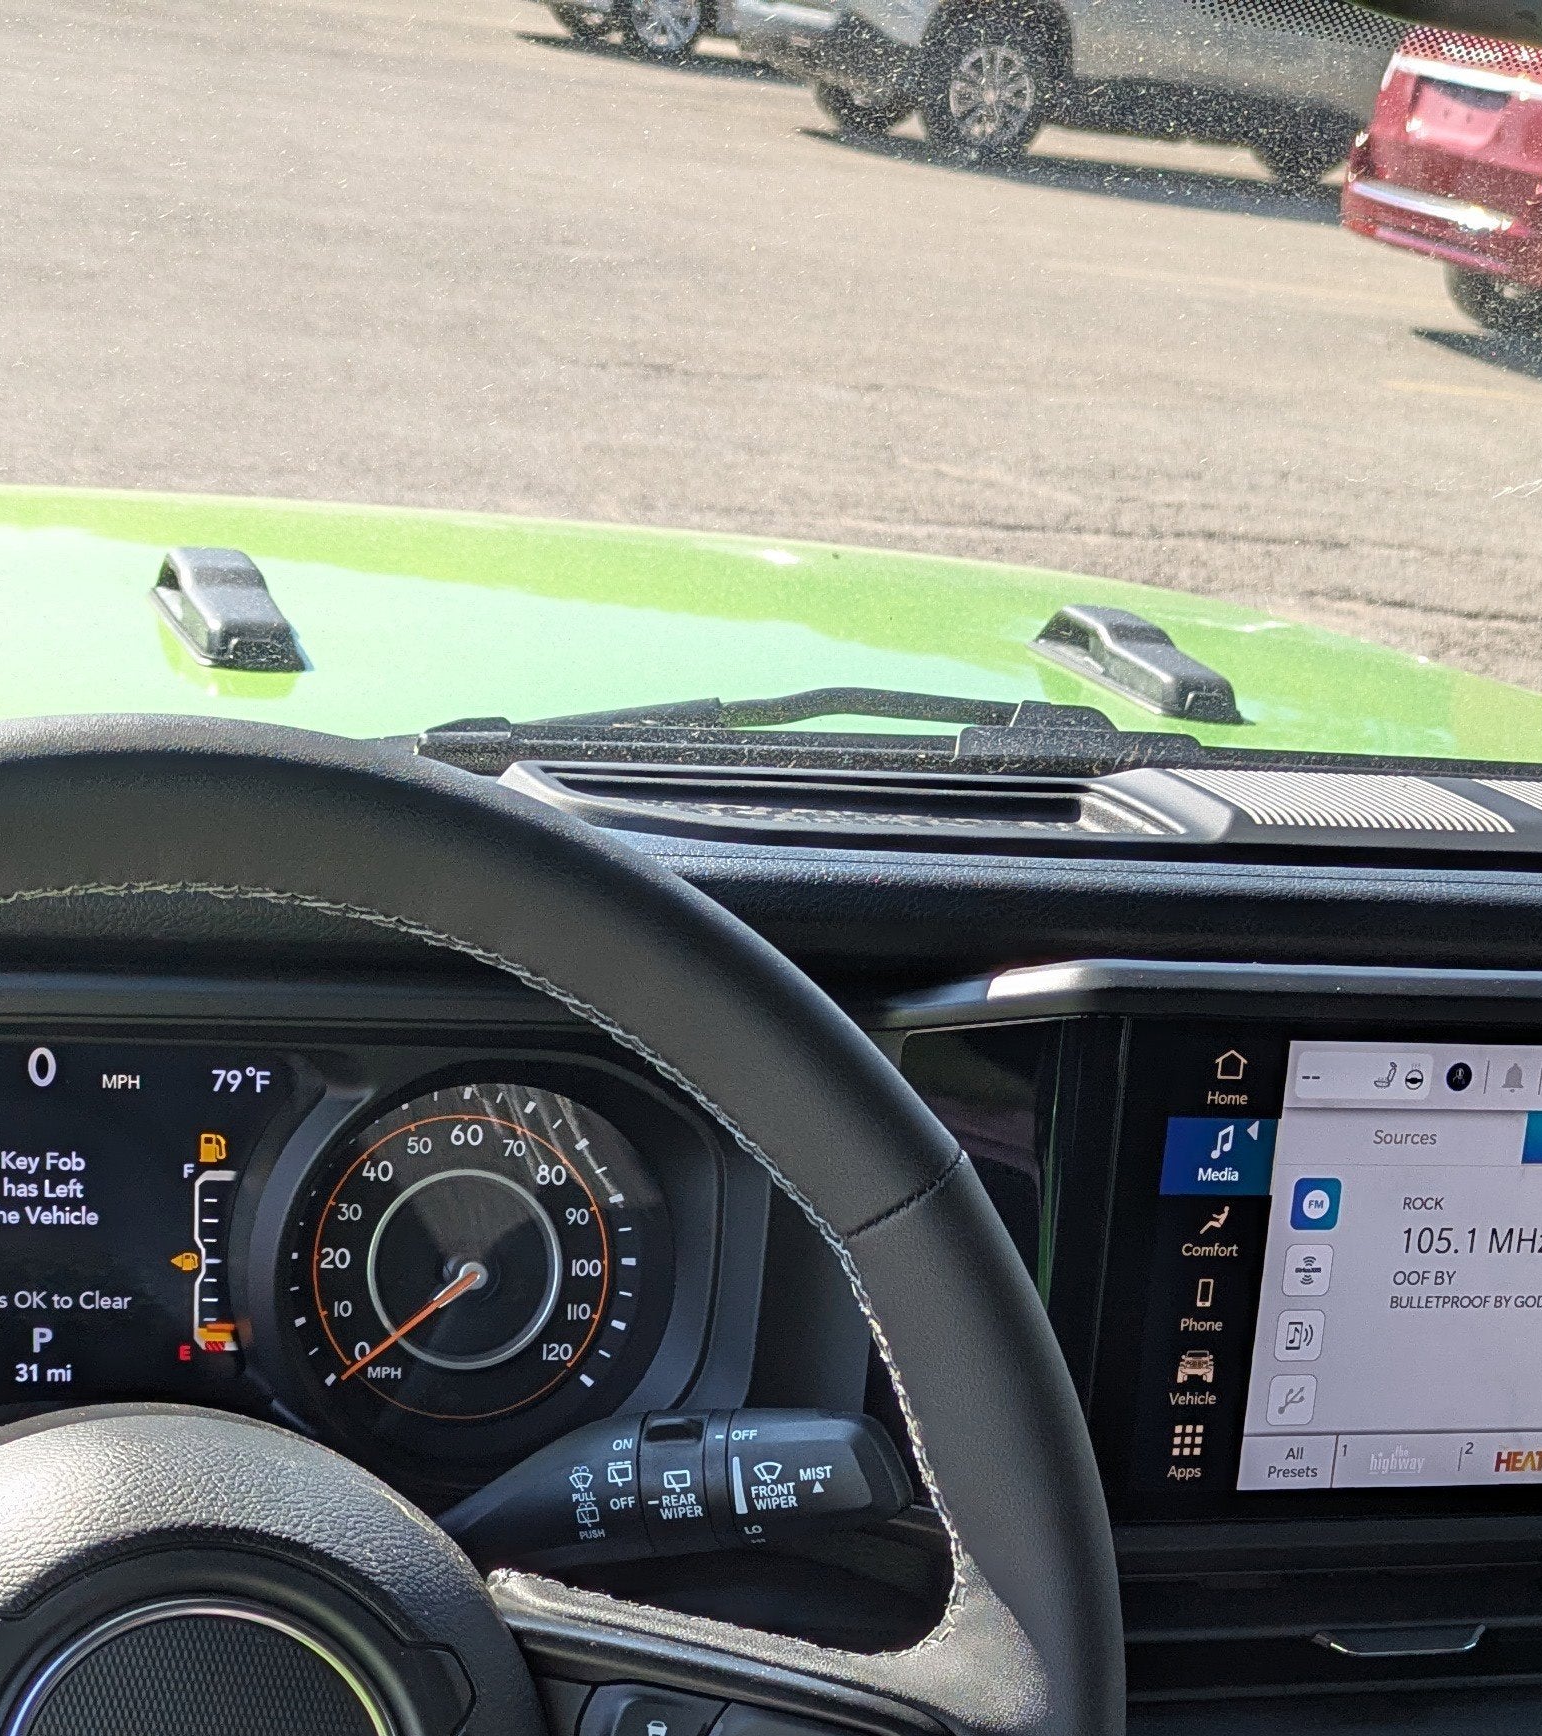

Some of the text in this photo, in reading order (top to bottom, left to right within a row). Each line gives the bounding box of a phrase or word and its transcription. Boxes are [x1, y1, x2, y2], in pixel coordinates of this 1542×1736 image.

[28, 1047, 140, 1089] 0 MPH
[212, 1067, 271, 1092] 79°F
[1207, 1091, 1248, 1106] Home
[450, 1124, 483, 1146] 60
[1373, 1130, 1437, 1146] Sources
[407, 1137, 432, 1154] 50
[503, 1140, 525, 1156] 70
[1, 1151, 85, 1175] Key Fob
[183, 1164, 194, 1178] F
[362, 1161, 393, 1182] 40
[536, 1165, 566, 1186] 80
[1198, 1167, 1239, 1181] Media
[4, 1179, 83, 1199] has Left
[1308, 1200, 1324, 1209] FM
[1403, 1197, 1443, 1210] ROCK
[25, 1207, 99, 1225] Vehicle
[337, 1204, 362, 1220] 30
[565, 1208, 588, 1225] 90
[1403, 1227, 1476, 1254] 105.1
[1182, 1243, 1238, 1257] Comfort
[320, 1248, 350, 1269] 20
[571, 1259, 602, 1277] 100
[1393, 1271, 1456, 1286] OOF BY
[14, 1291, 47, 1309] OK
[53, 1293, 73, 1309] to
[79, 1291, 131, 1310] Clear
[1390, 1296, 1490, 1309] BULLETPROOF
[1493, 1296, 1512, 1308] BY
[334, 1301, 352, 1317] 10
[567, 1304, 590, 1320] 110
[1180, 1318, 1223, 1332] Phone
[33, 1328, 53, 1352] P
[179, 1347, 191, 1361] E
[542, 1343, 572, 1361] 120
[15, 1365, 72, 1382] 31 mi
[367, 1367, 401, 1379] MPH
[1169, 1392, 1216, 1405] Vehicle
[731, 1430, 757, 1440] OFF
[613, 1439, 632, 1450] ON
[1285, 1447, 1304, 1460] All
[1370, 1452, 1425, 1474] highway
[799, 1466, 832, 1481] MIST
[1167, 1465, 1201, 1480] Apps
[1268, 1464, 1318, 1478] Presets
[751, 1483, 795, 1498] FRONT
[610, 1497, 635, 1510] OFF
[662, 1494, 696, 1506] REAR
[754, 1496, 798, 1510] WIPER
[660, 1506, 703, 1519] WIPER
